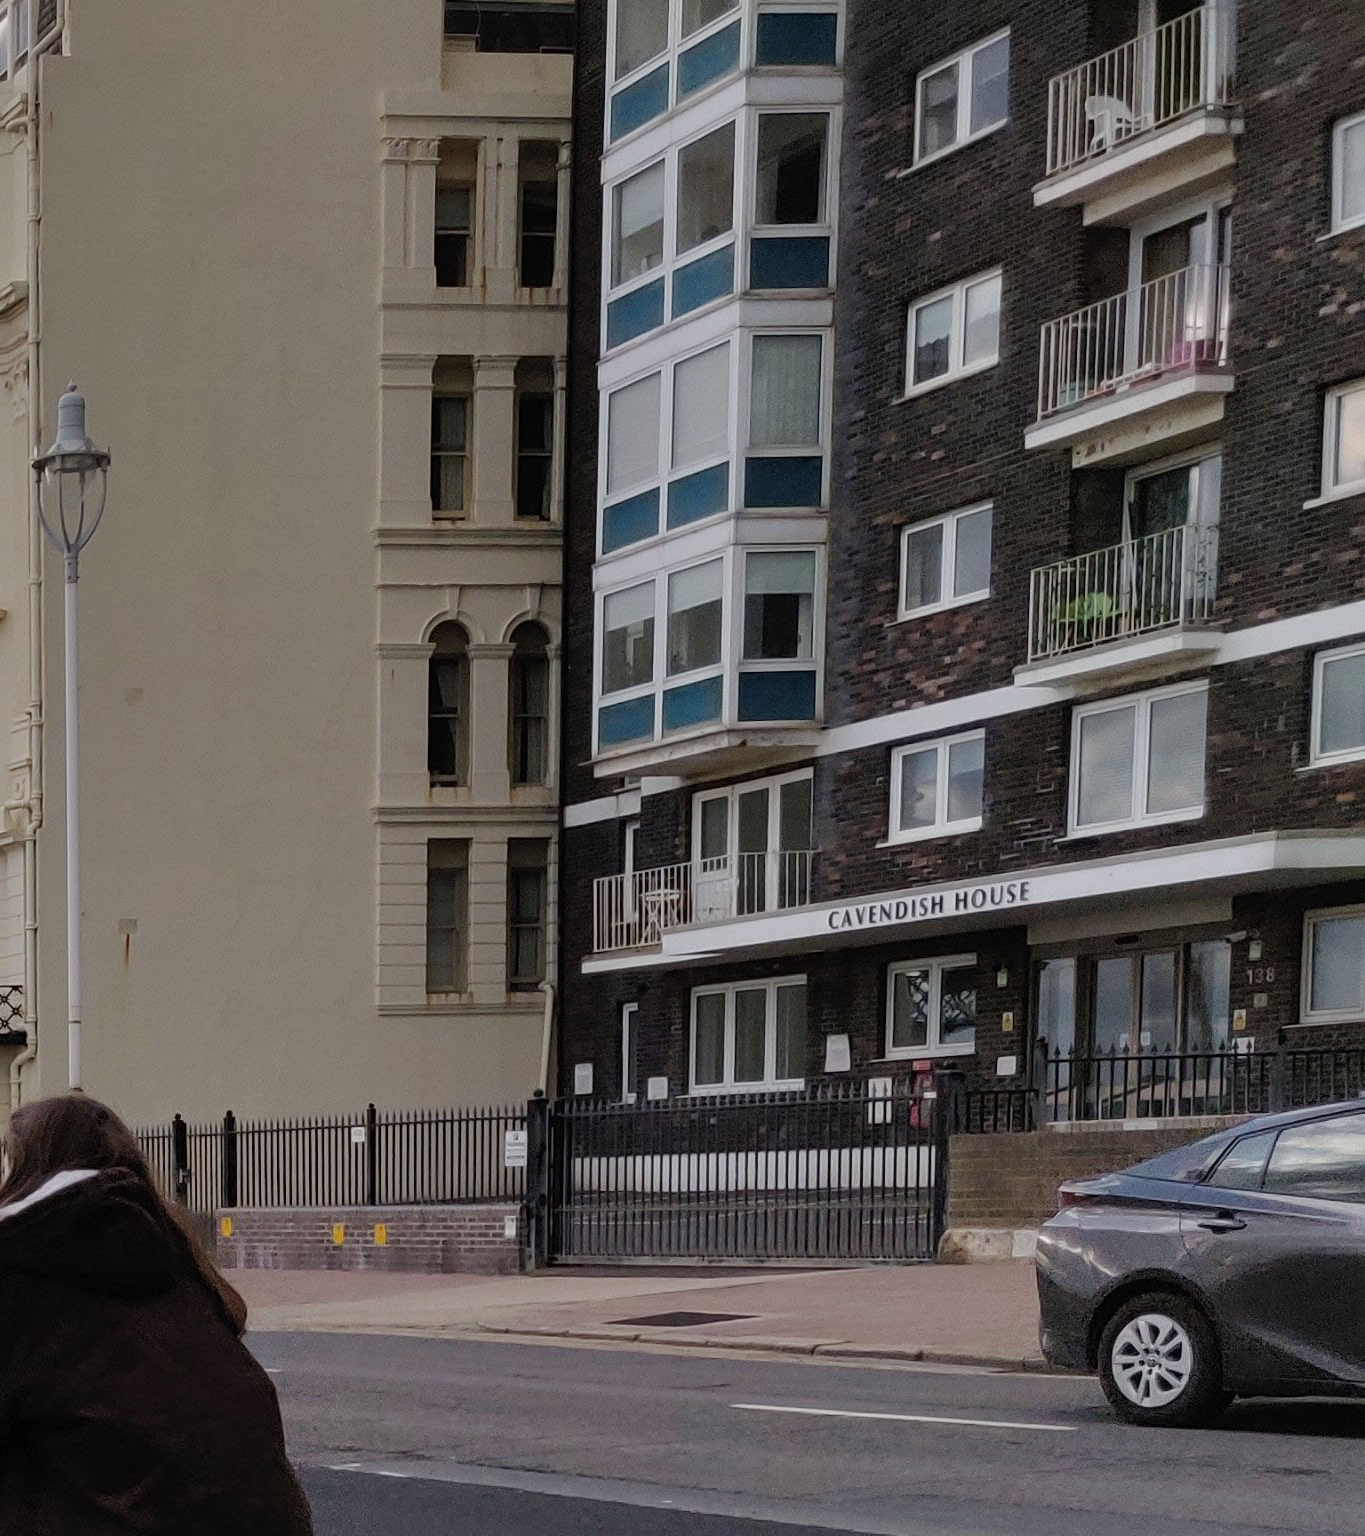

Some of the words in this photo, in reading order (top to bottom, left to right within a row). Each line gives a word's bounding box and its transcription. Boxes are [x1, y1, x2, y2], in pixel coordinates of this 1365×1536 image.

[828, 894, 944, 930] CAVENDISH
[954, 881, 1030, 912] HOUSE
[1247, 967, 1274, 984] 138
